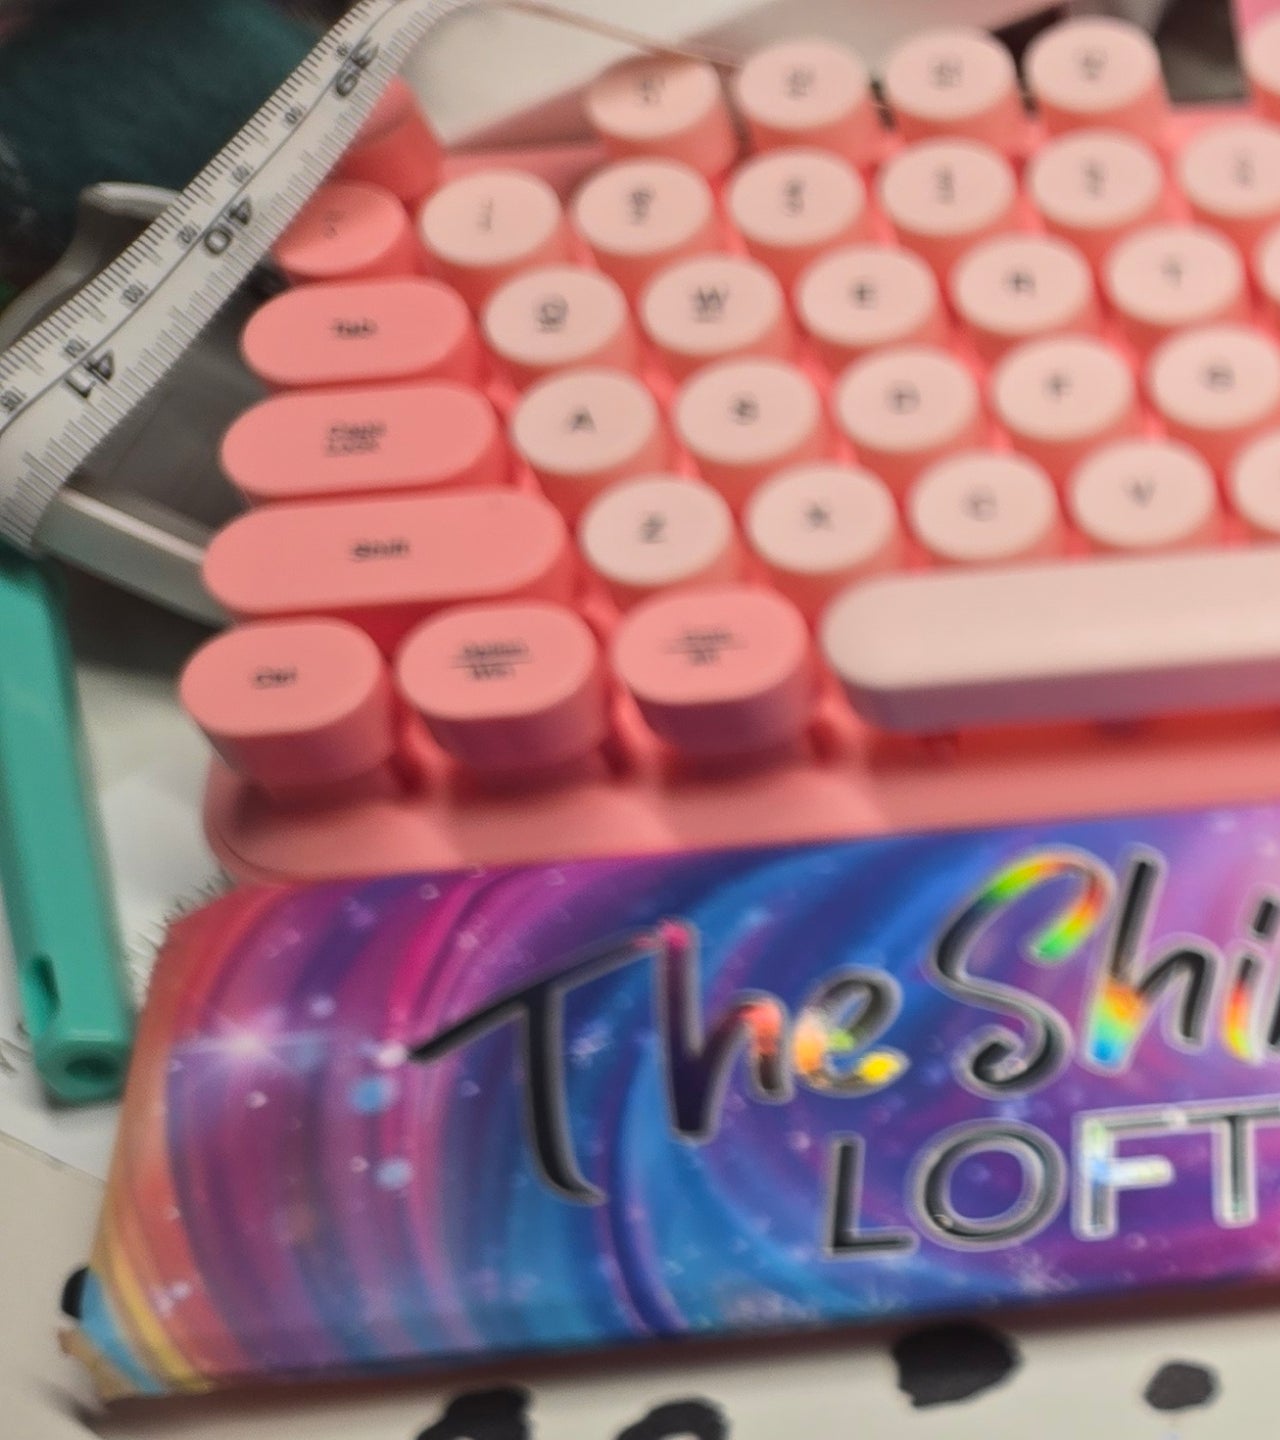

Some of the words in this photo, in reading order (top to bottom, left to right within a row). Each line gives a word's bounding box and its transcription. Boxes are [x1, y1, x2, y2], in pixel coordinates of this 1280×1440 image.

[334, 36, 380, 98] 39
[203, 195, 254, 256] 40
[65, 350, 117, 401] 41
[408, 922, 908, 1203] The
